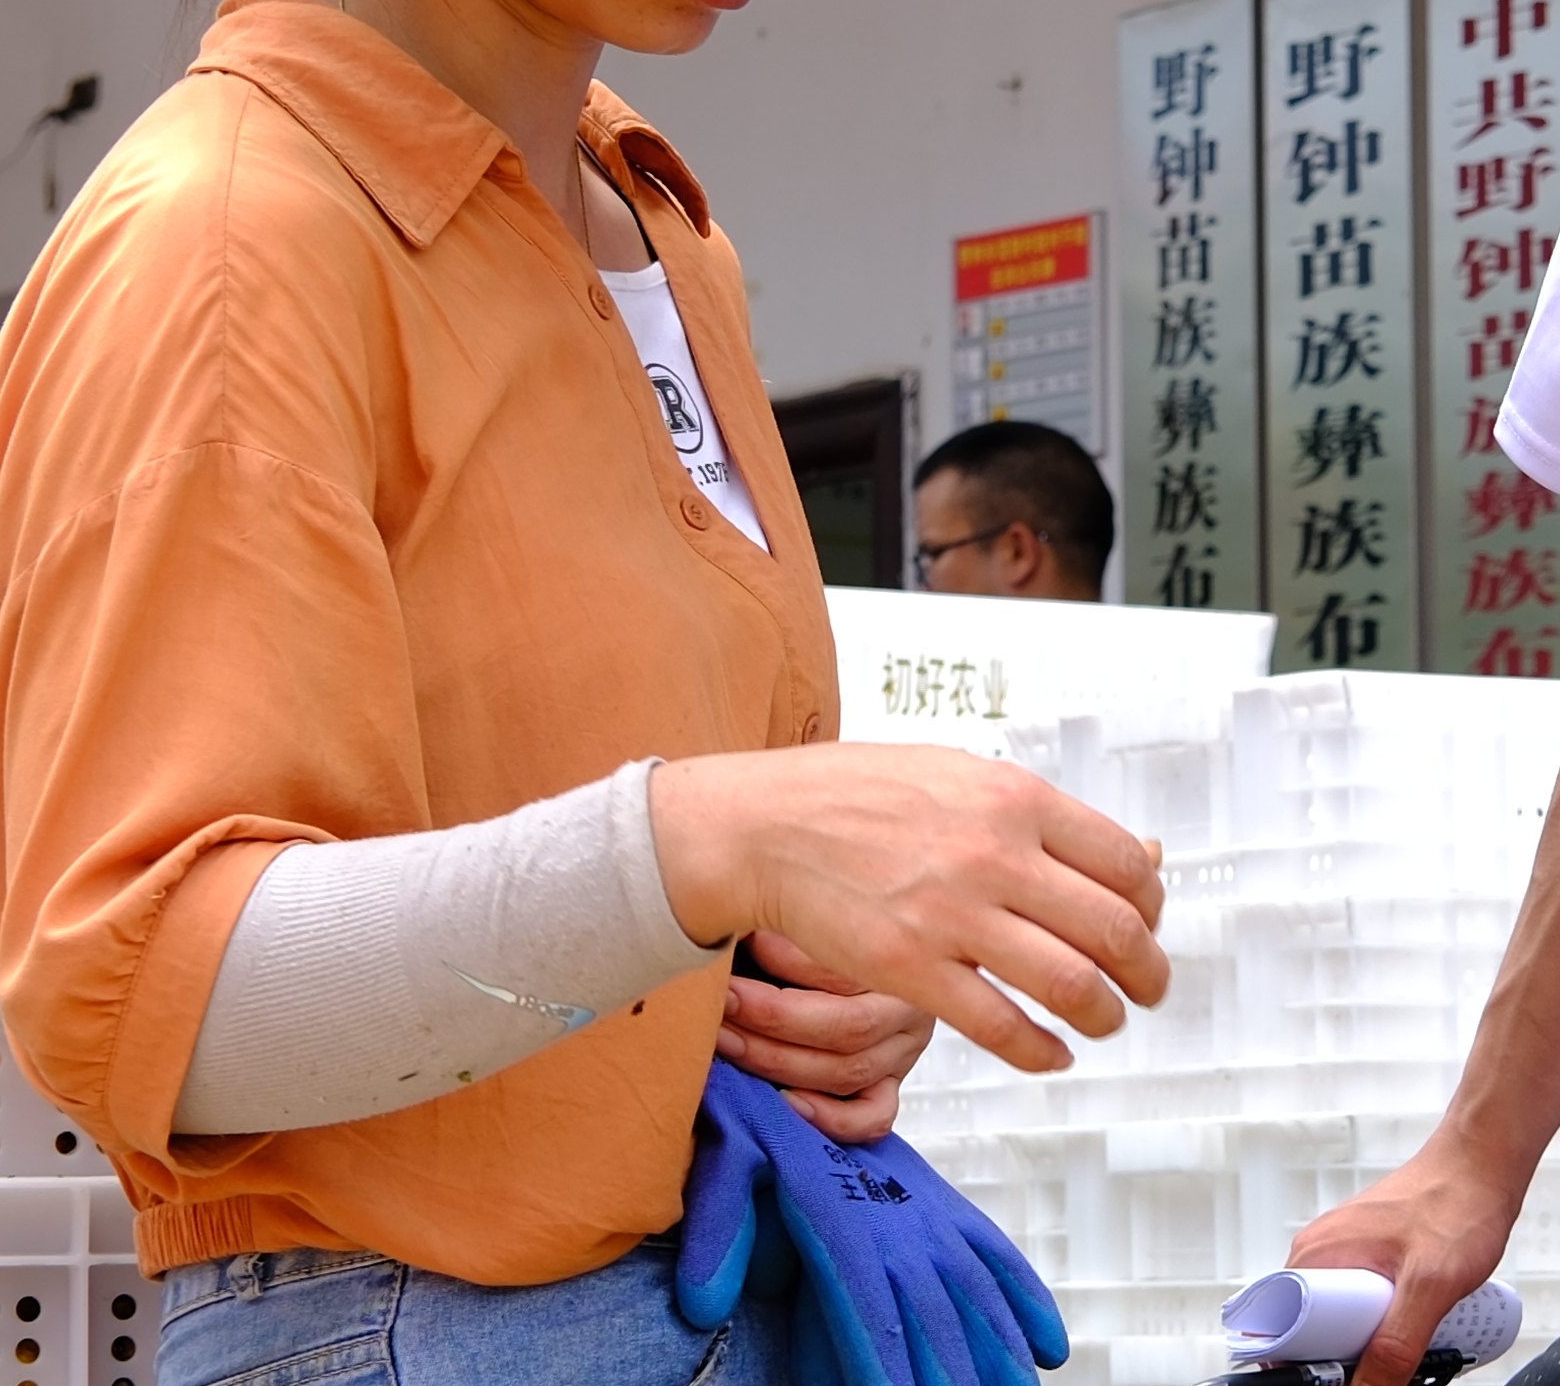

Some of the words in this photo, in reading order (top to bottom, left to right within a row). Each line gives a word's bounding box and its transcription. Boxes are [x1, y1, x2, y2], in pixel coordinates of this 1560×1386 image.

[1150, 43, 1221, 608] 野钟苗族彝族布
[1284, 24, 1389, 669] 野钟苗族彝族布
[881, 652, 1010, 720] 初好农业
